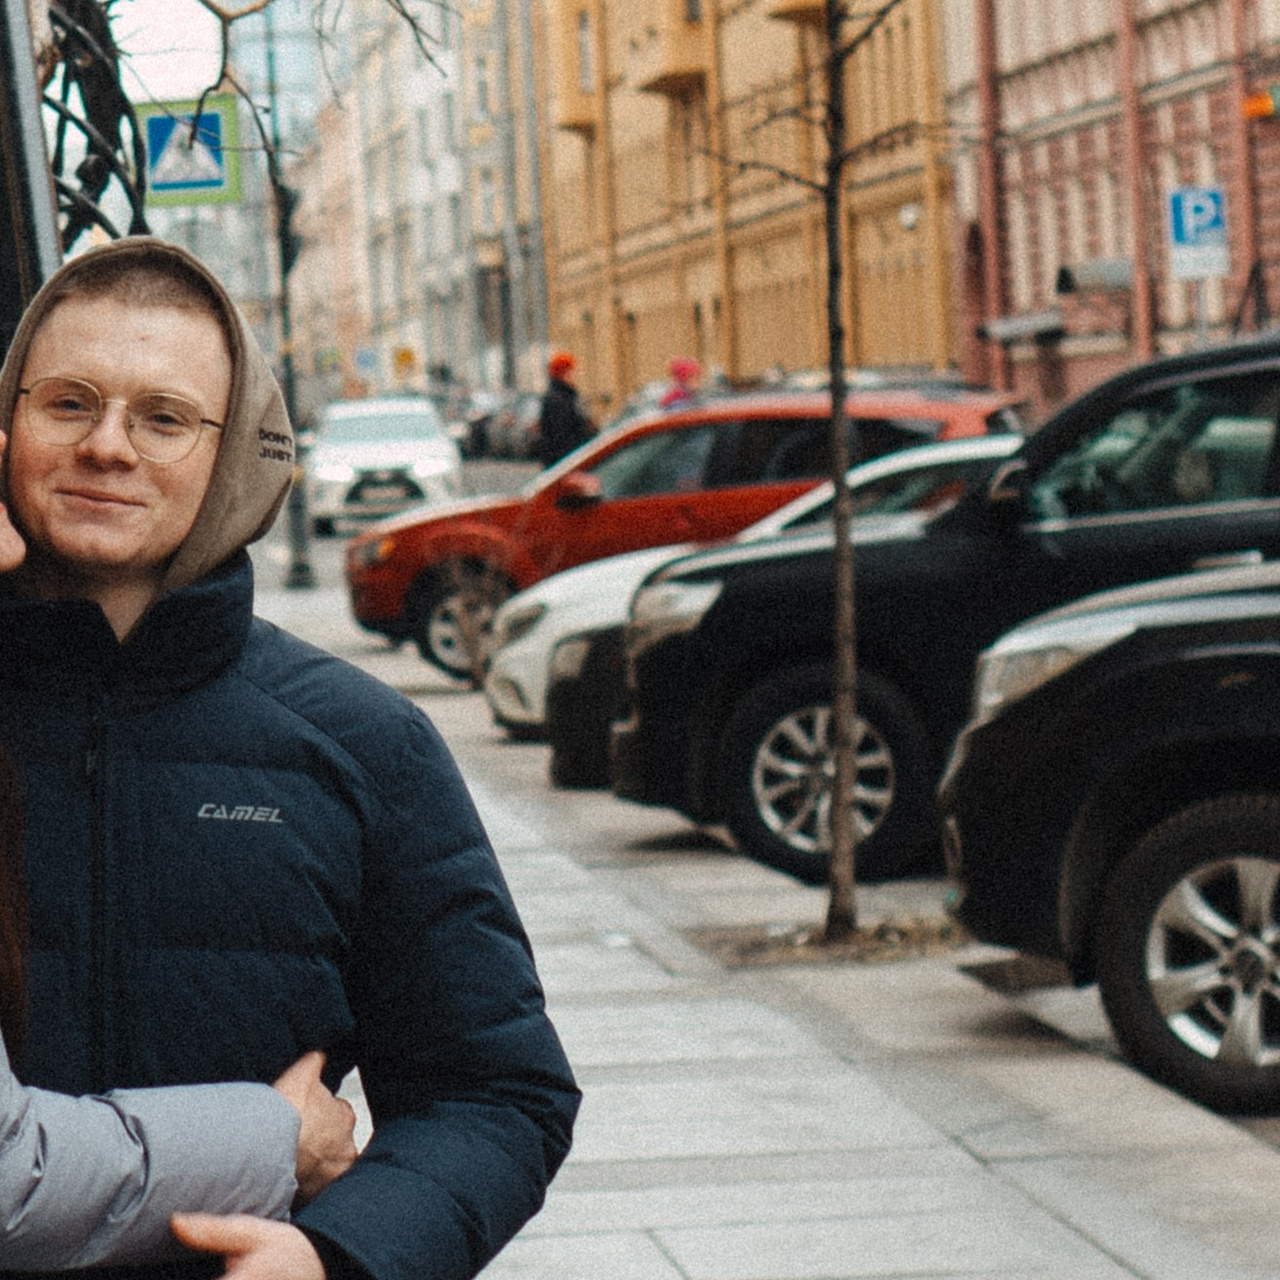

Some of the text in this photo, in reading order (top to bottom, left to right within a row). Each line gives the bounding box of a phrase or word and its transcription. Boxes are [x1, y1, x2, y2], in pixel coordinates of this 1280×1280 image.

[1182, 192, 1216, 243] P
[259, 447, 292, 463] JUST
[197, 803, 283, 823] CAMEL
